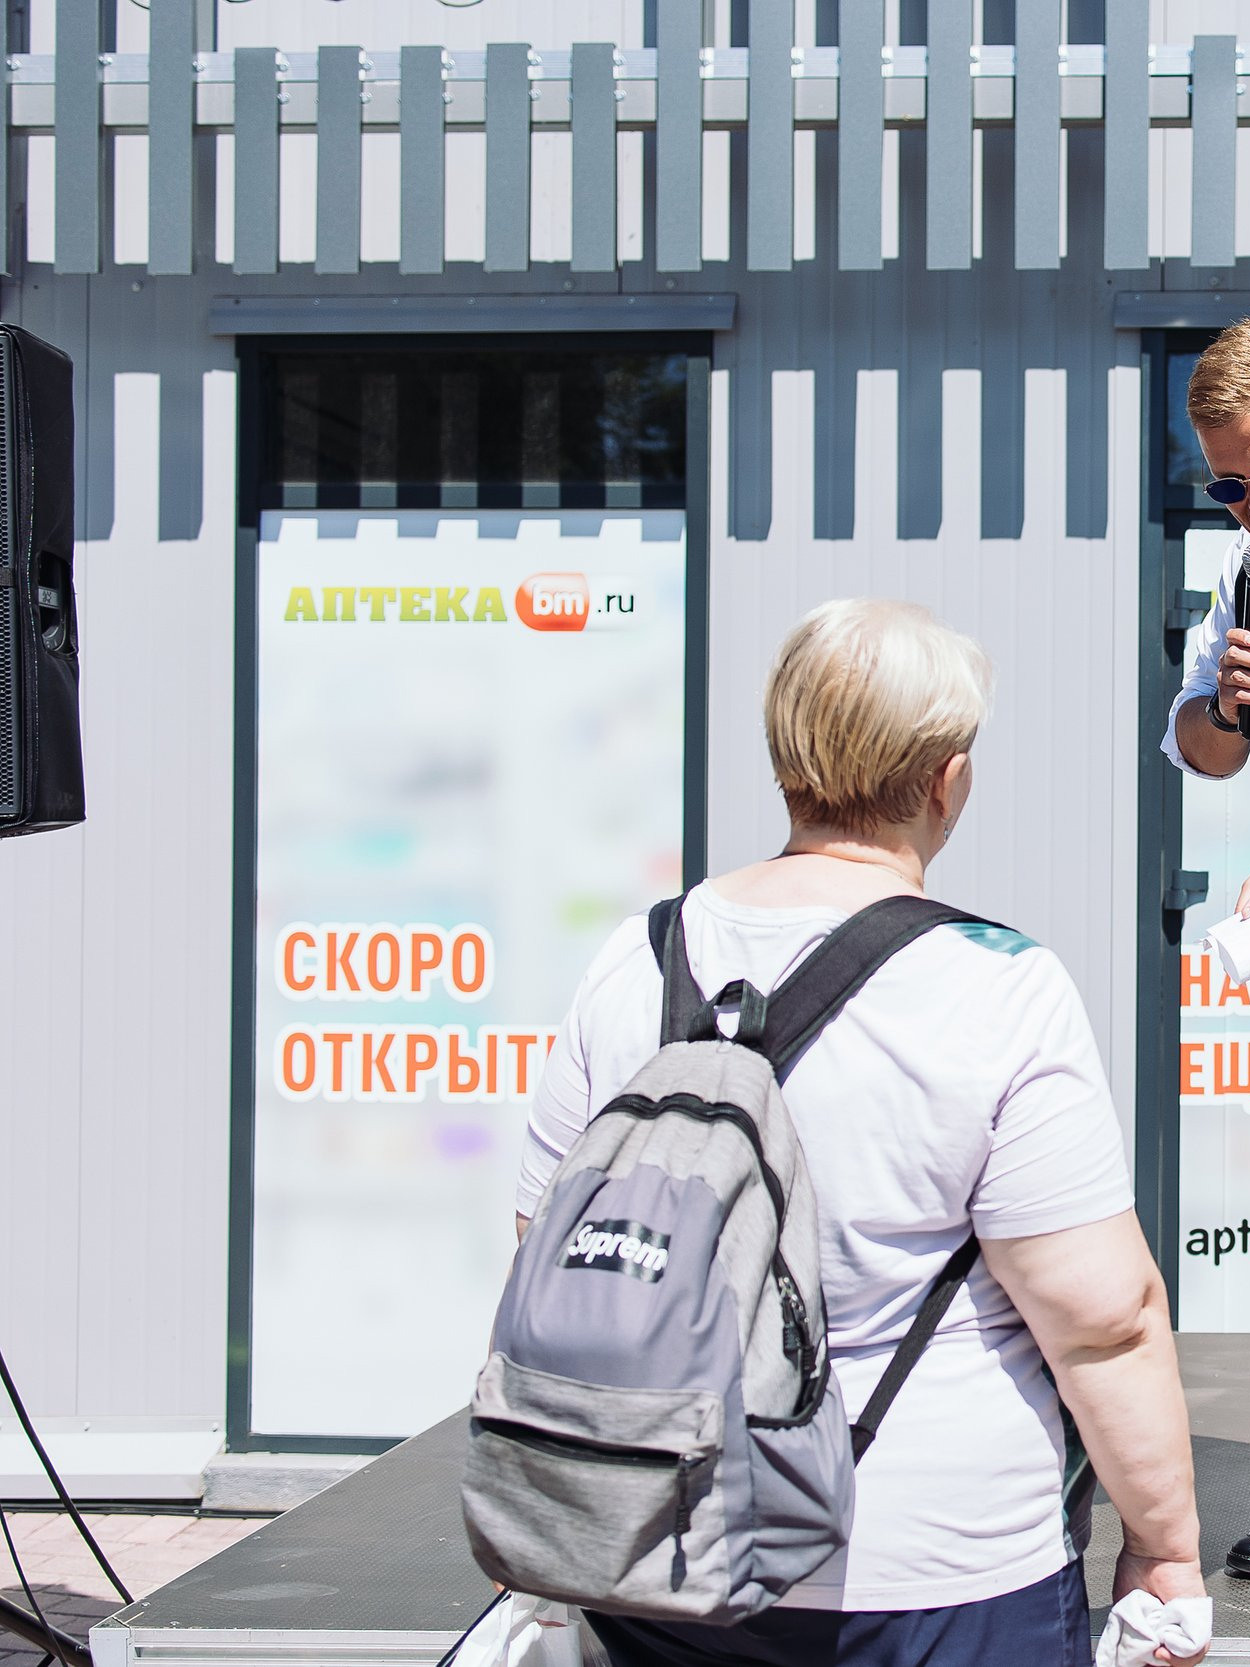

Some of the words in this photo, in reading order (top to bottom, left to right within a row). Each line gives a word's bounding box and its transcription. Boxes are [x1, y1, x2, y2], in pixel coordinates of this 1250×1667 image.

[284, 586, 508, 622] АПТЕКА
[283, 931, 486, 993] СКОРО
[282, 1031, 558, 1095] ОТКРЫТ
[567, 1223, 669, 1271] Suprem
